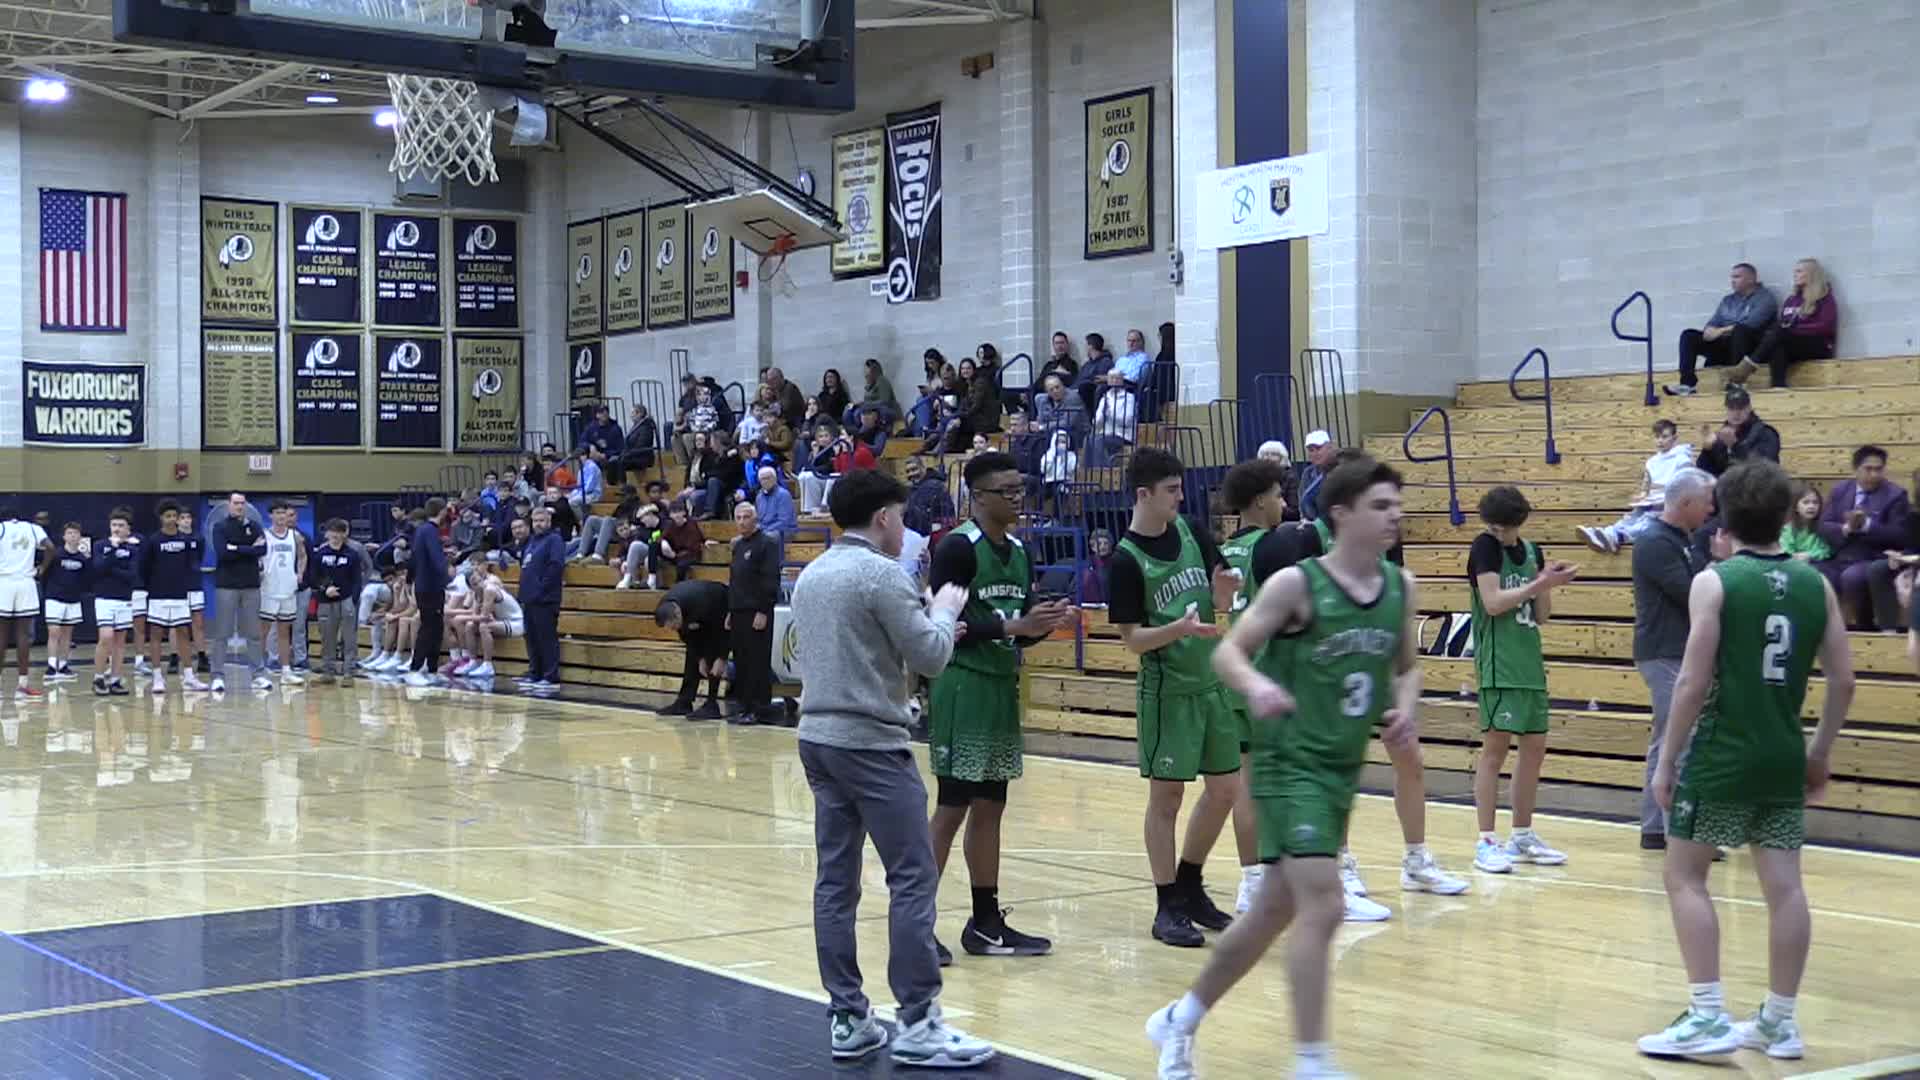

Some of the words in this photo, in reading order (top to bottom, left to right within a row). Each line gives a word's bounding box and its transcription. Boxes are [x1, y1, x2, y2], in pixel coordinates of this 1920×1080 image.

[1105, 107, 1132, 122] GIRLS
[896, 123, 932, 140] WARRIOR
[1102, 122, 1135, 138] SOCCER
[896, 139, 932, 239] FOCUS
[1106, 194, 1129, 208] 1987
[223, 209, 254, 220] GIRLS
[1103, 211, 1130, 226] STATE
[206, 220, 243, 231] WINTER
[244, 222, 273, 233] TRACK
[1089, 225, 1146, 245] CHAMPIONS
[312, 255, 343, 265] CLASS
[389, 260, 426, 270] LEAGUE
[296, 265, 358, 276] CHAMPIONS
[467, 263, 505, 273] LEAGUE
[378, 270, 438, 282] CHAMPIONS
[457, 273, 515, 283] CHAMPIONS
[210, 288, 269, 300] ALL-STATE
[205, 301, 273, 313] CHAMPIONS
[207, 335, 241, 343] SPRING
[244, 335, 273, 343] TRACK
[475, 345, 503, 354] GIRLS
[459, 356, 492, 365] SPRING
[493, 357, 518, 366] TRACK
[27, 369, 140, 401] FOXBOROUGH
[311, 379, 342, 388] CLASS
[379, 382, 408, 391] STATE
[296, 389, 358, 399] CHAMPIONS
[379, 391, 439, 402] CHAMPIONS
[35, 405, 133, 437] WARRIORS
[465, 421, 515, 431] ALL-STATE
[977, 584, 1026, 600] MANSFIEL
[1761, 614, 1792, 681] 2
[1341, 671, 1373, 716] 3
